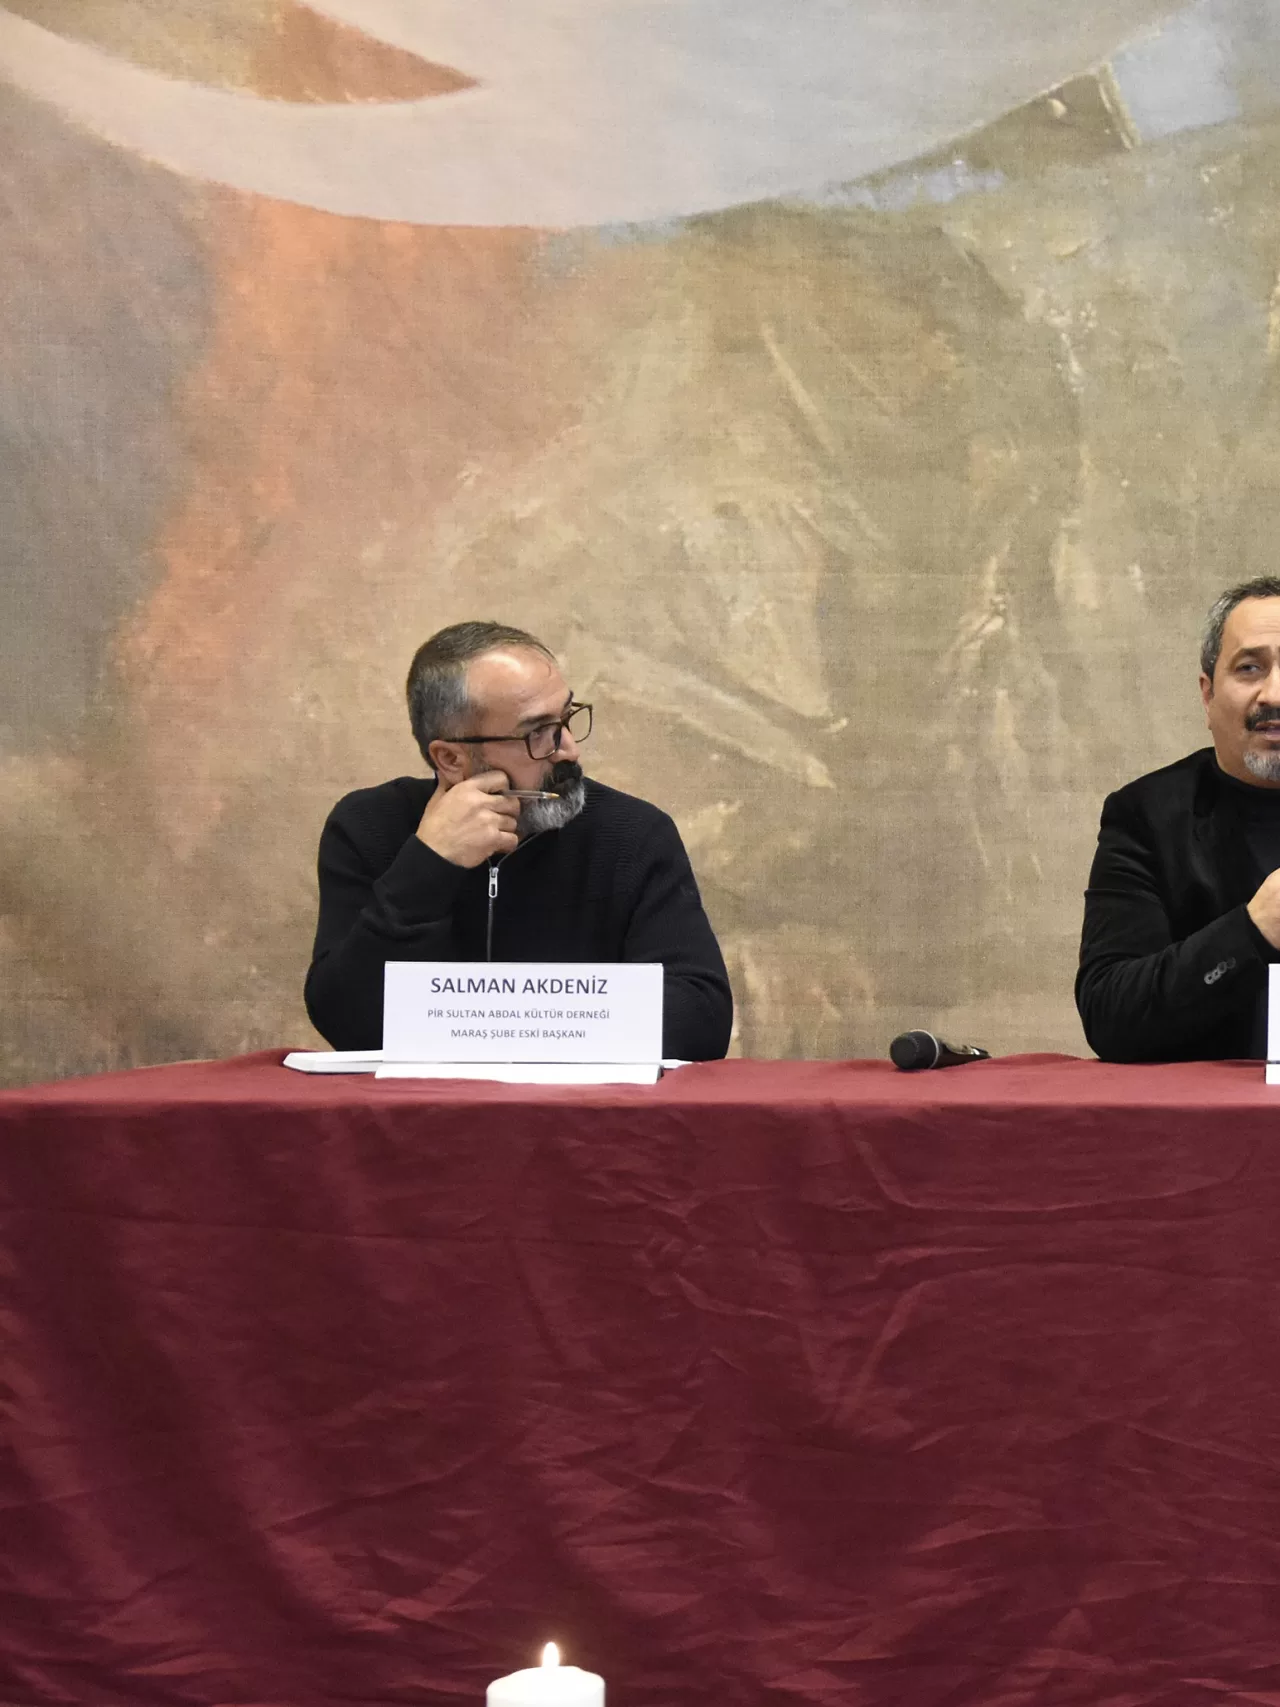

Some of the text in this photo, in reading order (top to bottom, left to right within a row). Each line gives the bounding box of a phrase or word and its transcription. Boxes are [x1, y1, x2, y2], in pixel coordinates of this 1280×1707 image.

[430, 974, 608, 995] SALMAN AKDENİZ
[427, 1007, 610, 1019] PİR SULTAN ABDAL KÜLTÜR DERNEĞİ
[450, 1028, 586, 1040] MARAŞ ŞUBE ESKİ BAŞKANI
